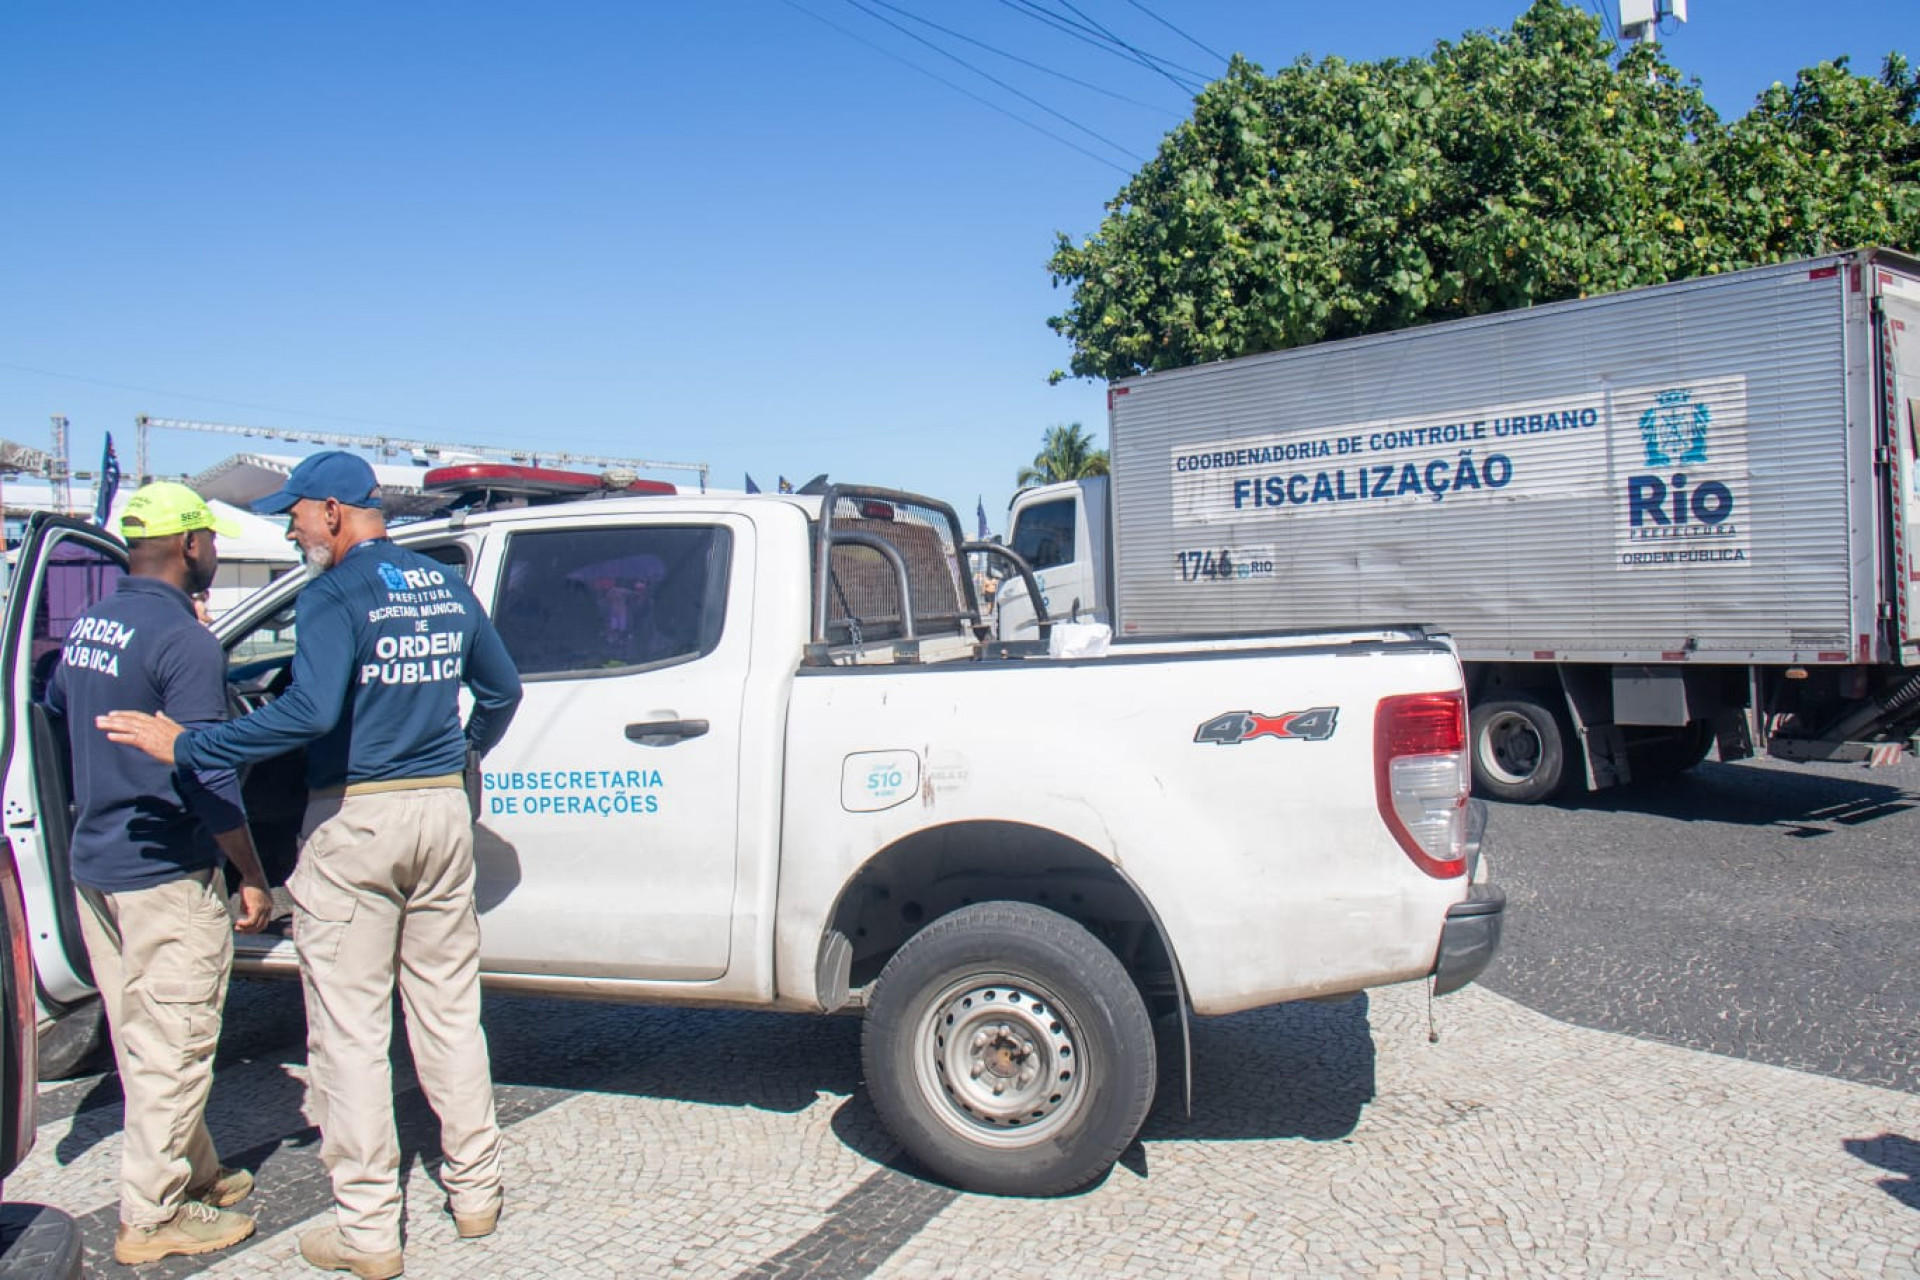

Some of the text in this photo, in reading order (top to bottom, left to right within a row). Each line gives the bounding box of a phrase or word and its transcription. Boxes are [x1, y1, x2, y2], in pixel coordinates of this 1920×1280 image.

[1176, 407, 1598, 472] COORDENADORIA DE CONTROLE URBANO
[1234, 448, 1514, 509] FISCALIZAÇÃO
[1627, 472, 1733, 526] Rio
[1178, 549, 1233, 581] 1746
[1251, 560, 1273, 573] RIO
[1622, 546, 1745, 565] ORDEM PÚBLICA
[402, 567, 446, 590] Rio
[69, 616, 136, 650] ORDEM
[414, 619, 429, 633] DE
[376, 631, 464, 660] ORDEM
[360, 657, 463, 685] PÚBLICA
[483, 769, 664, 790] SUBSECRETARIA
[866, 771, 903, 790] S10
[491, 790, 659, 818] DE OPERAÇÕES
